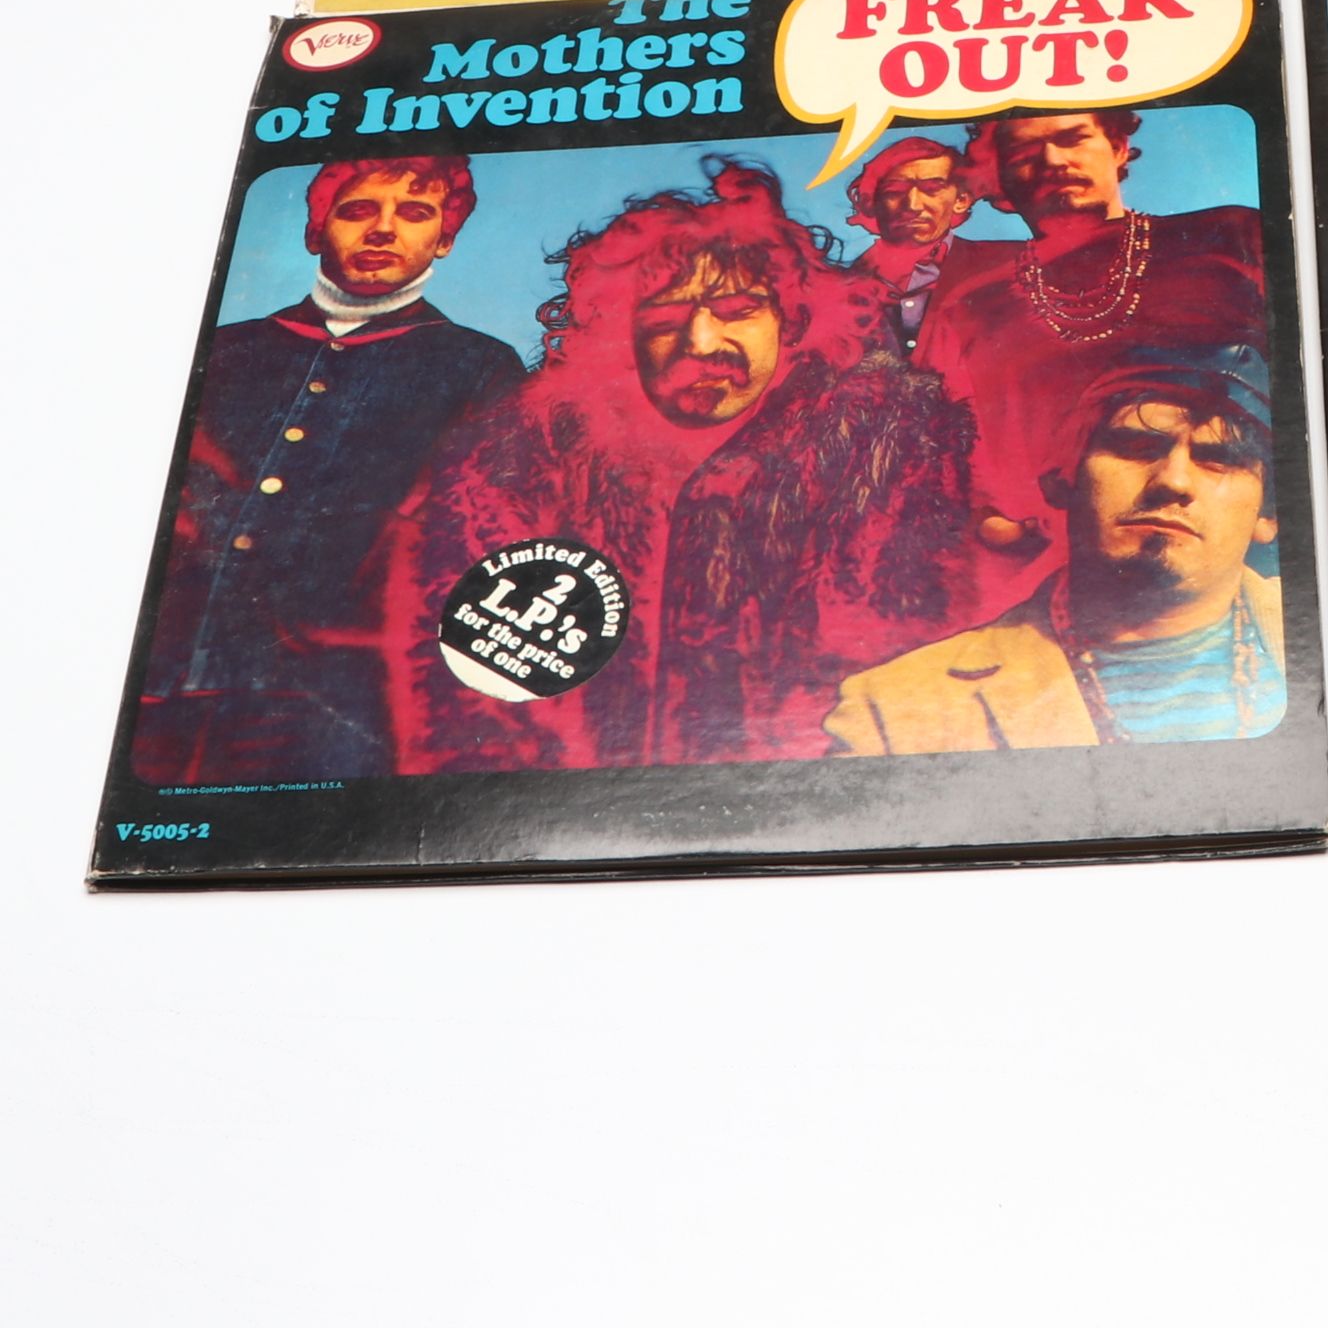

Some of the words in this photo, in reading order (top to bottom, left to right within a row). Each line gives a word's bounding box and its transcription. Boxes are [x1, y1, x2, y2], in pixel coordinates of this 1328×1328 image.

[294, 33, 369, 56] Verve
[422, 27, 746, 83] Mothers
[879, 28, 1129, 98] OUT!
[254, 91, 340, 143] of
[355, 72, 744, 135] Invention
[482, 543, 587, 577] Limited
[583, 559, 625, 638] Edition
[542, 574, 577, 605] 2
[454, 603, 490, 631] for
[487, 623, 522, 649] the
[517, 643, 575, 679] price
[471, 638, 499, 659] of
[493, 651, 532, 679] one
[116, 822, 210, 842] V-5005-2
